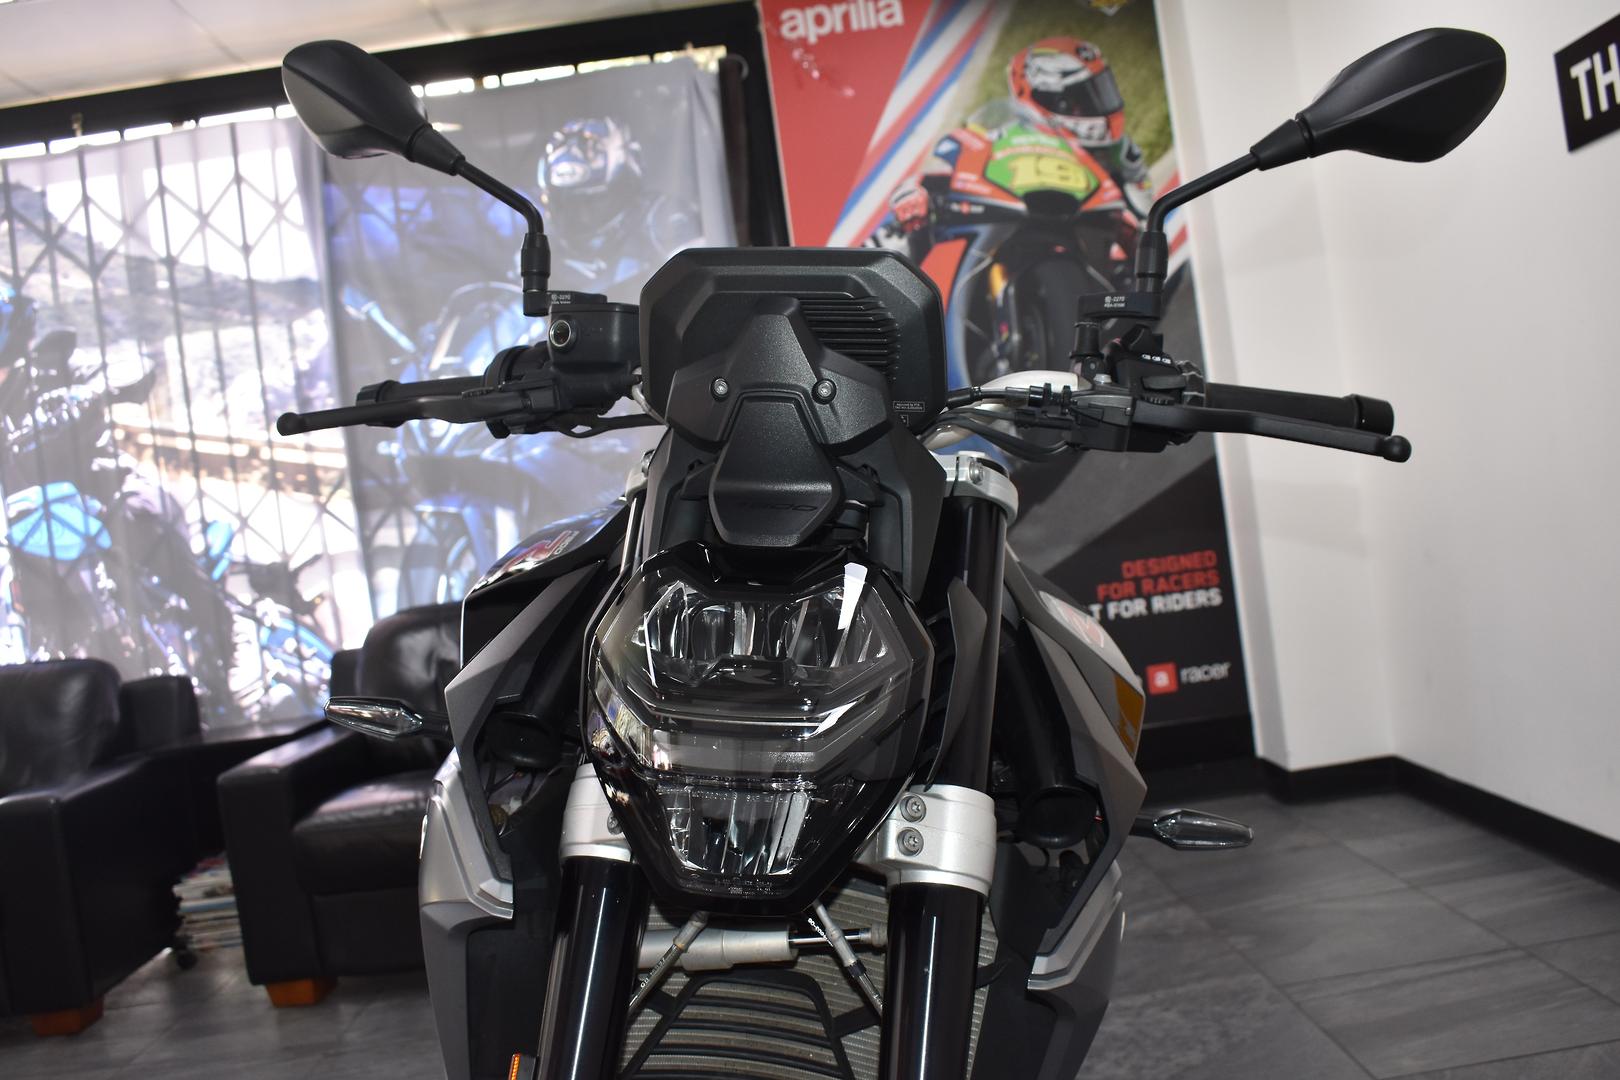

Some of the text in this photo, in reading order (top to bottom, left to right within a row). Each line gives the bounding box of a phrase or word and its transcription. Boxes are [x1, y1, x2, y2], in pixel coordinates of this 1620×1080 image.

[780, 0, 905, 45] aprilia
[1569, 42, 1620, 122] TH
[1121, 549, 1217, 579] DESIGNED
[1097, 569, 1219, 602] FOR RACERS
[1106, 597, 1148, 621] FOR
[1150, 586, 1223, 615] RIDERS
[1179, 662, 1231, 685] racer
